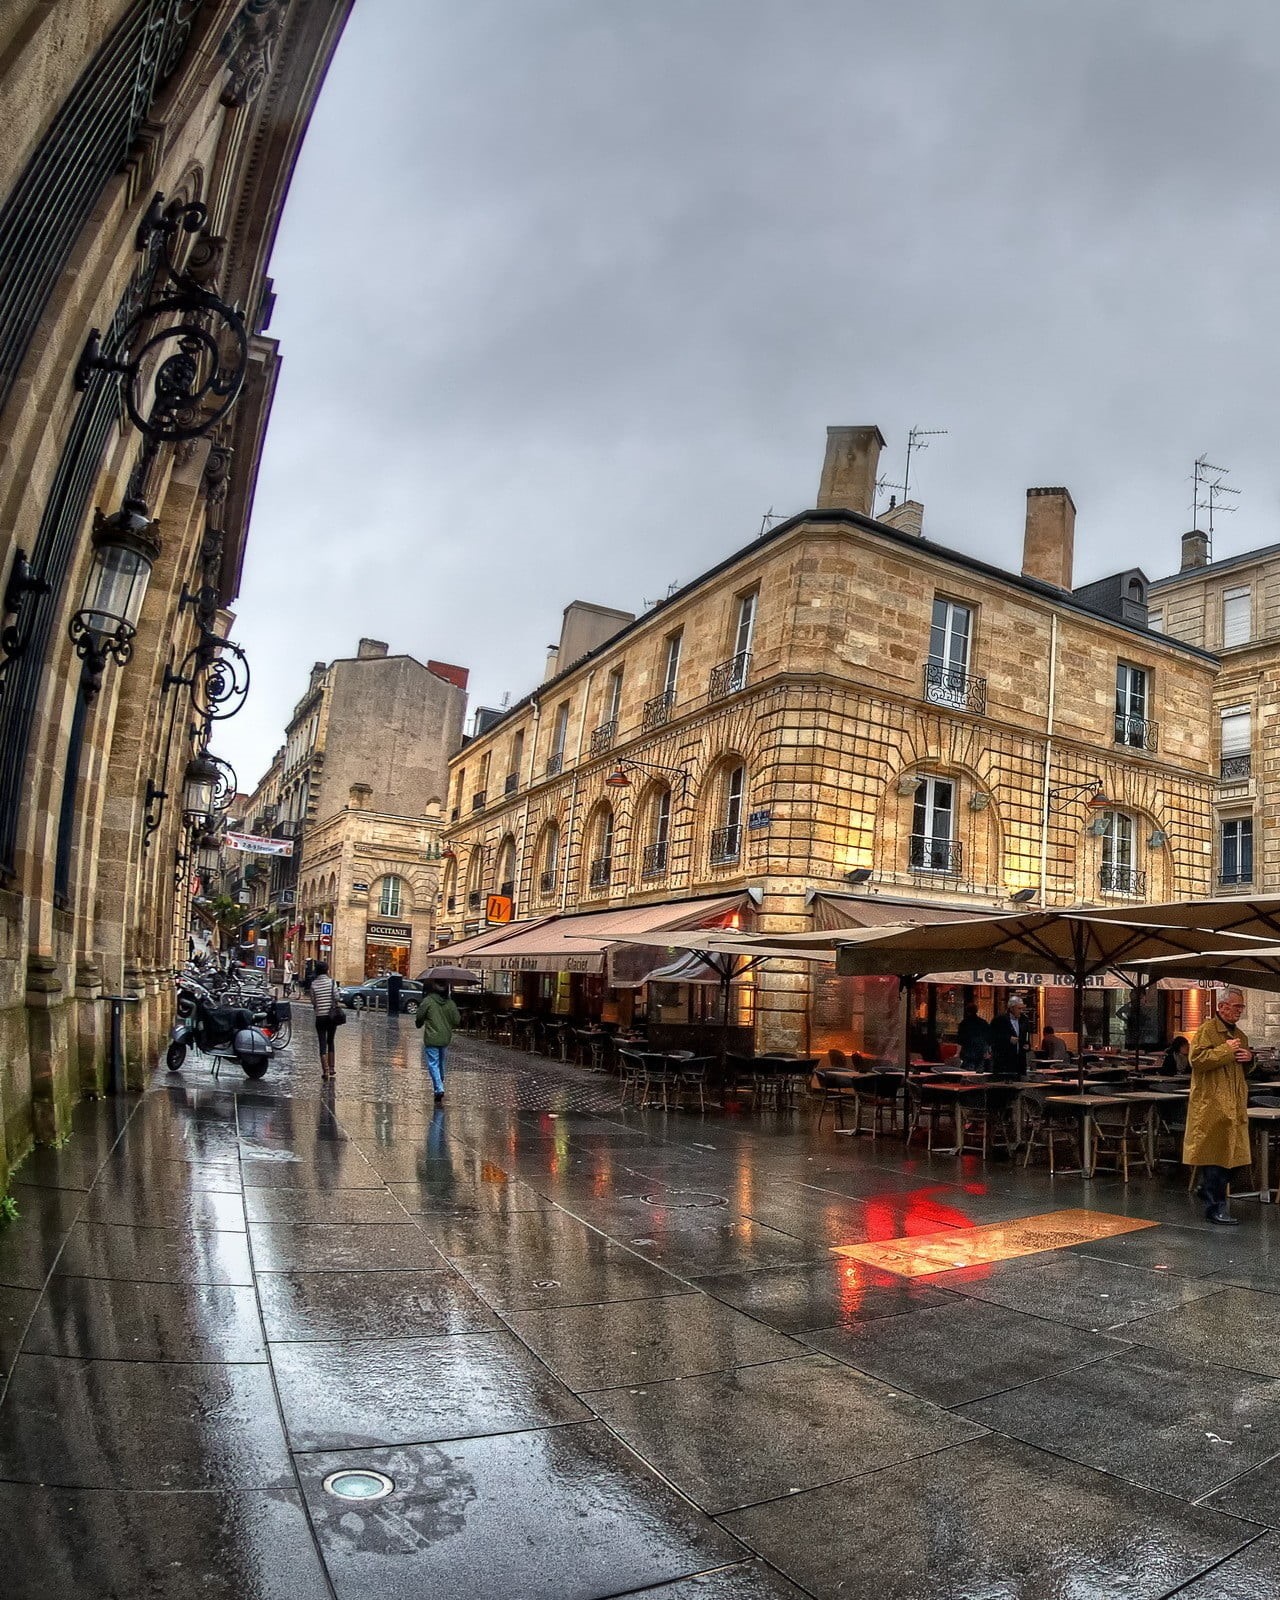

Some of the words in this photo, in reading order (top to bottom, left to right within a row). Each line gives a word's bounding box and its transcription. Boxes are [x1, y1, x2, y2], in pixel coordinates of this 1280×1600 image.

[371, 926, 407, 936] OCCITANIE
[567, 957, 588, 971] Glacier
[973, 970, 994, 983] Le
[1054, 973, 1105, 986] Roan
